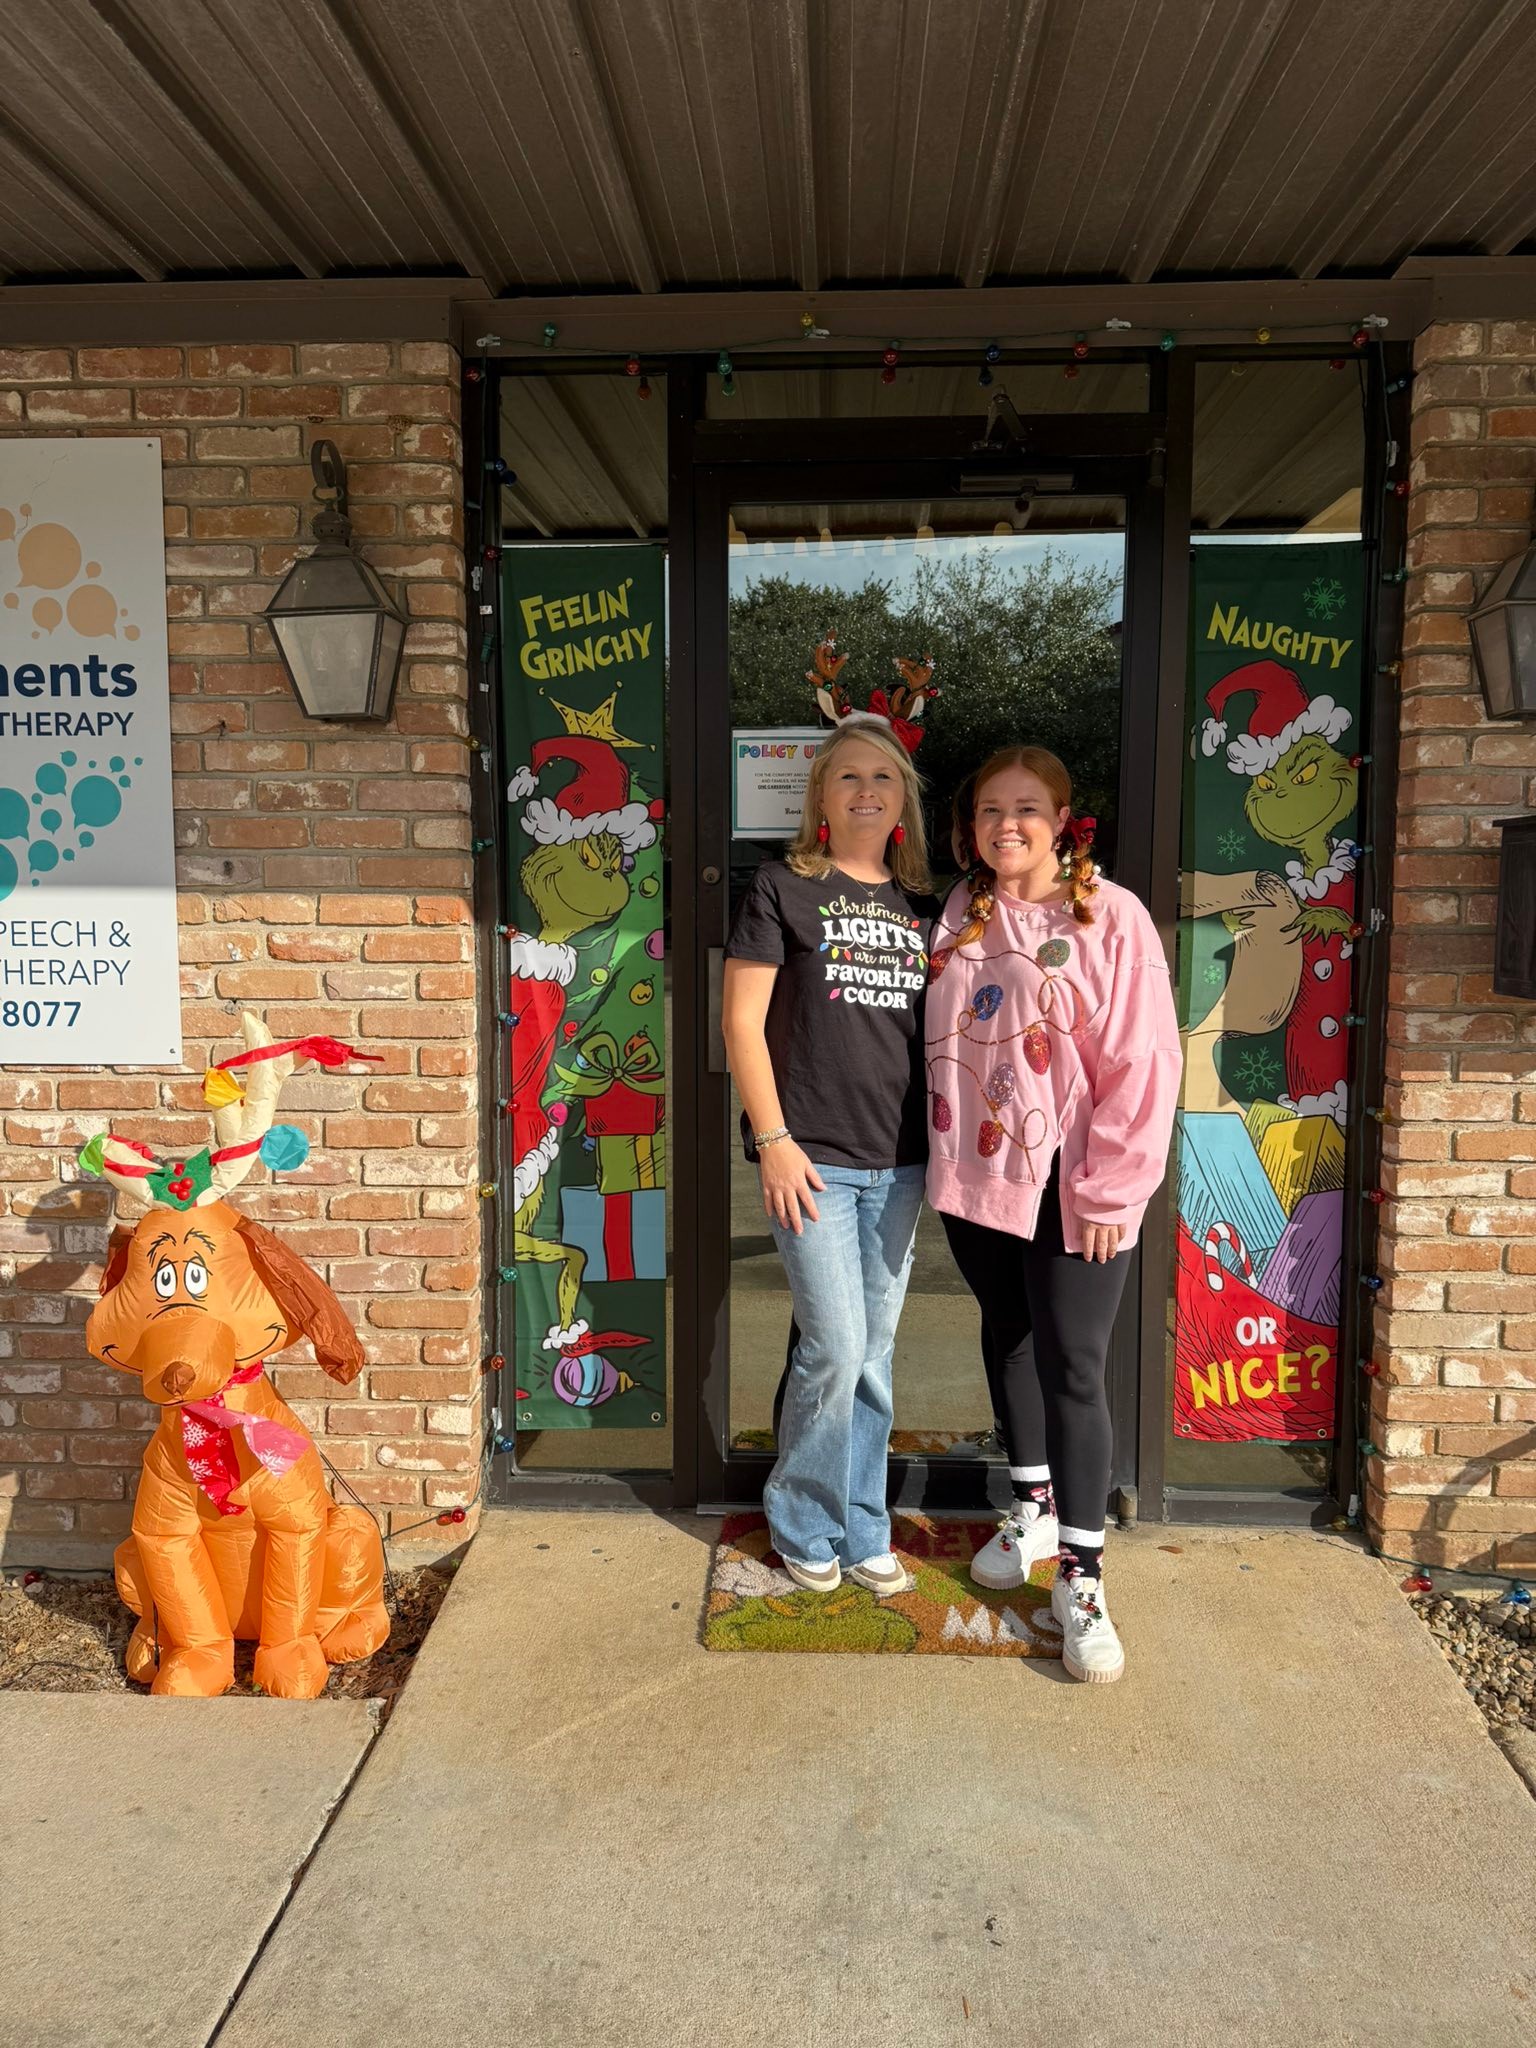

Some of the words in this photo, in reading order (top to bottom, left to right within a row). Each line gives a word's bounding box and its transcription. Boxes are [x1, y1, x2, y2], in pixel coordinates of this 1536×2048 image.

[520, 578, 634, 640] FEELIN'
[1207, 601, 1354, 669] NAUGHTY
[520, 622, 653, 680] GRINCHY
[0, 655, 137, 698] ents
[739, 744, 798, 759] POLICY
[829, 895, 910, 927] Christmas
[109, 920, 131, 947] &
[822, 918, 925, 951] LIGHTS
[0, 959, 131, 985] HERAPY
[854, 951, 878, 964] are
[879, 954, 902, 972] my
[2, 1000, 82, 1027] 8077
[843, 987, 908, 1009] COLOR
[1236, 1316, 1277, 1346] OR
[1189, 1345, 1330, 1409] NICE?
